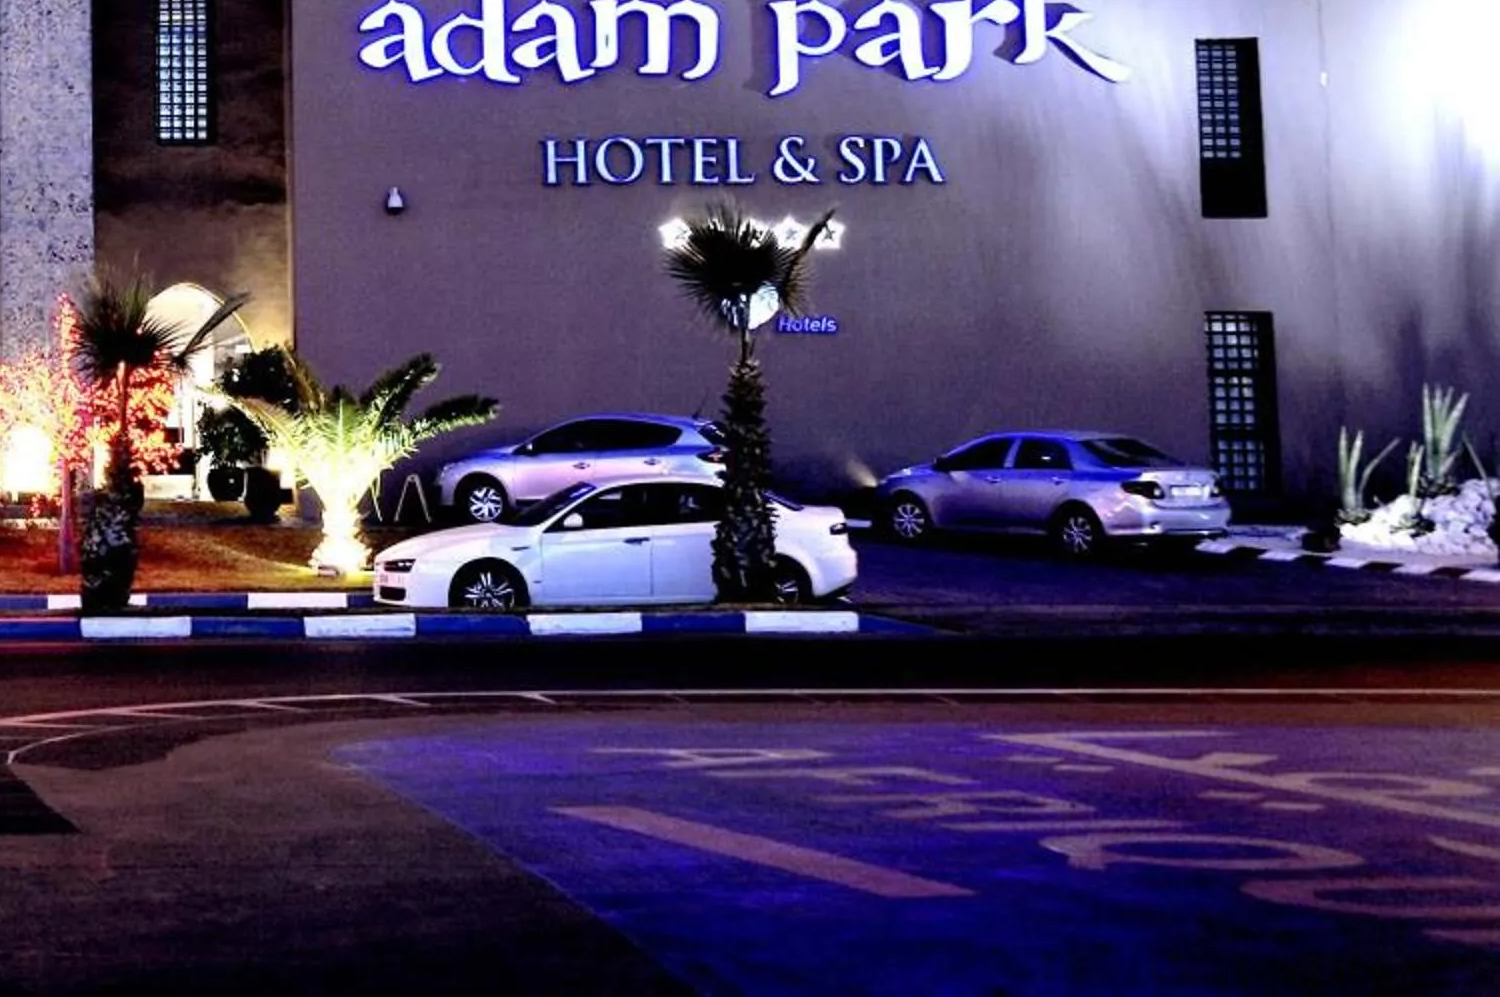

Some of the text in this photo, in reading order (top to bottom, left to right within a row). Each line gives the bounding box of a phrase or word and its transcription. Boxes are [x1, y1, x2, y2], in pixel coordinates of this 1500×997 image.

[543, 135, 945, 185] HOTEL & SPA
[777, 315, 838, 334] Hotels
[586, 746, 1500, 945] AFRIQU
